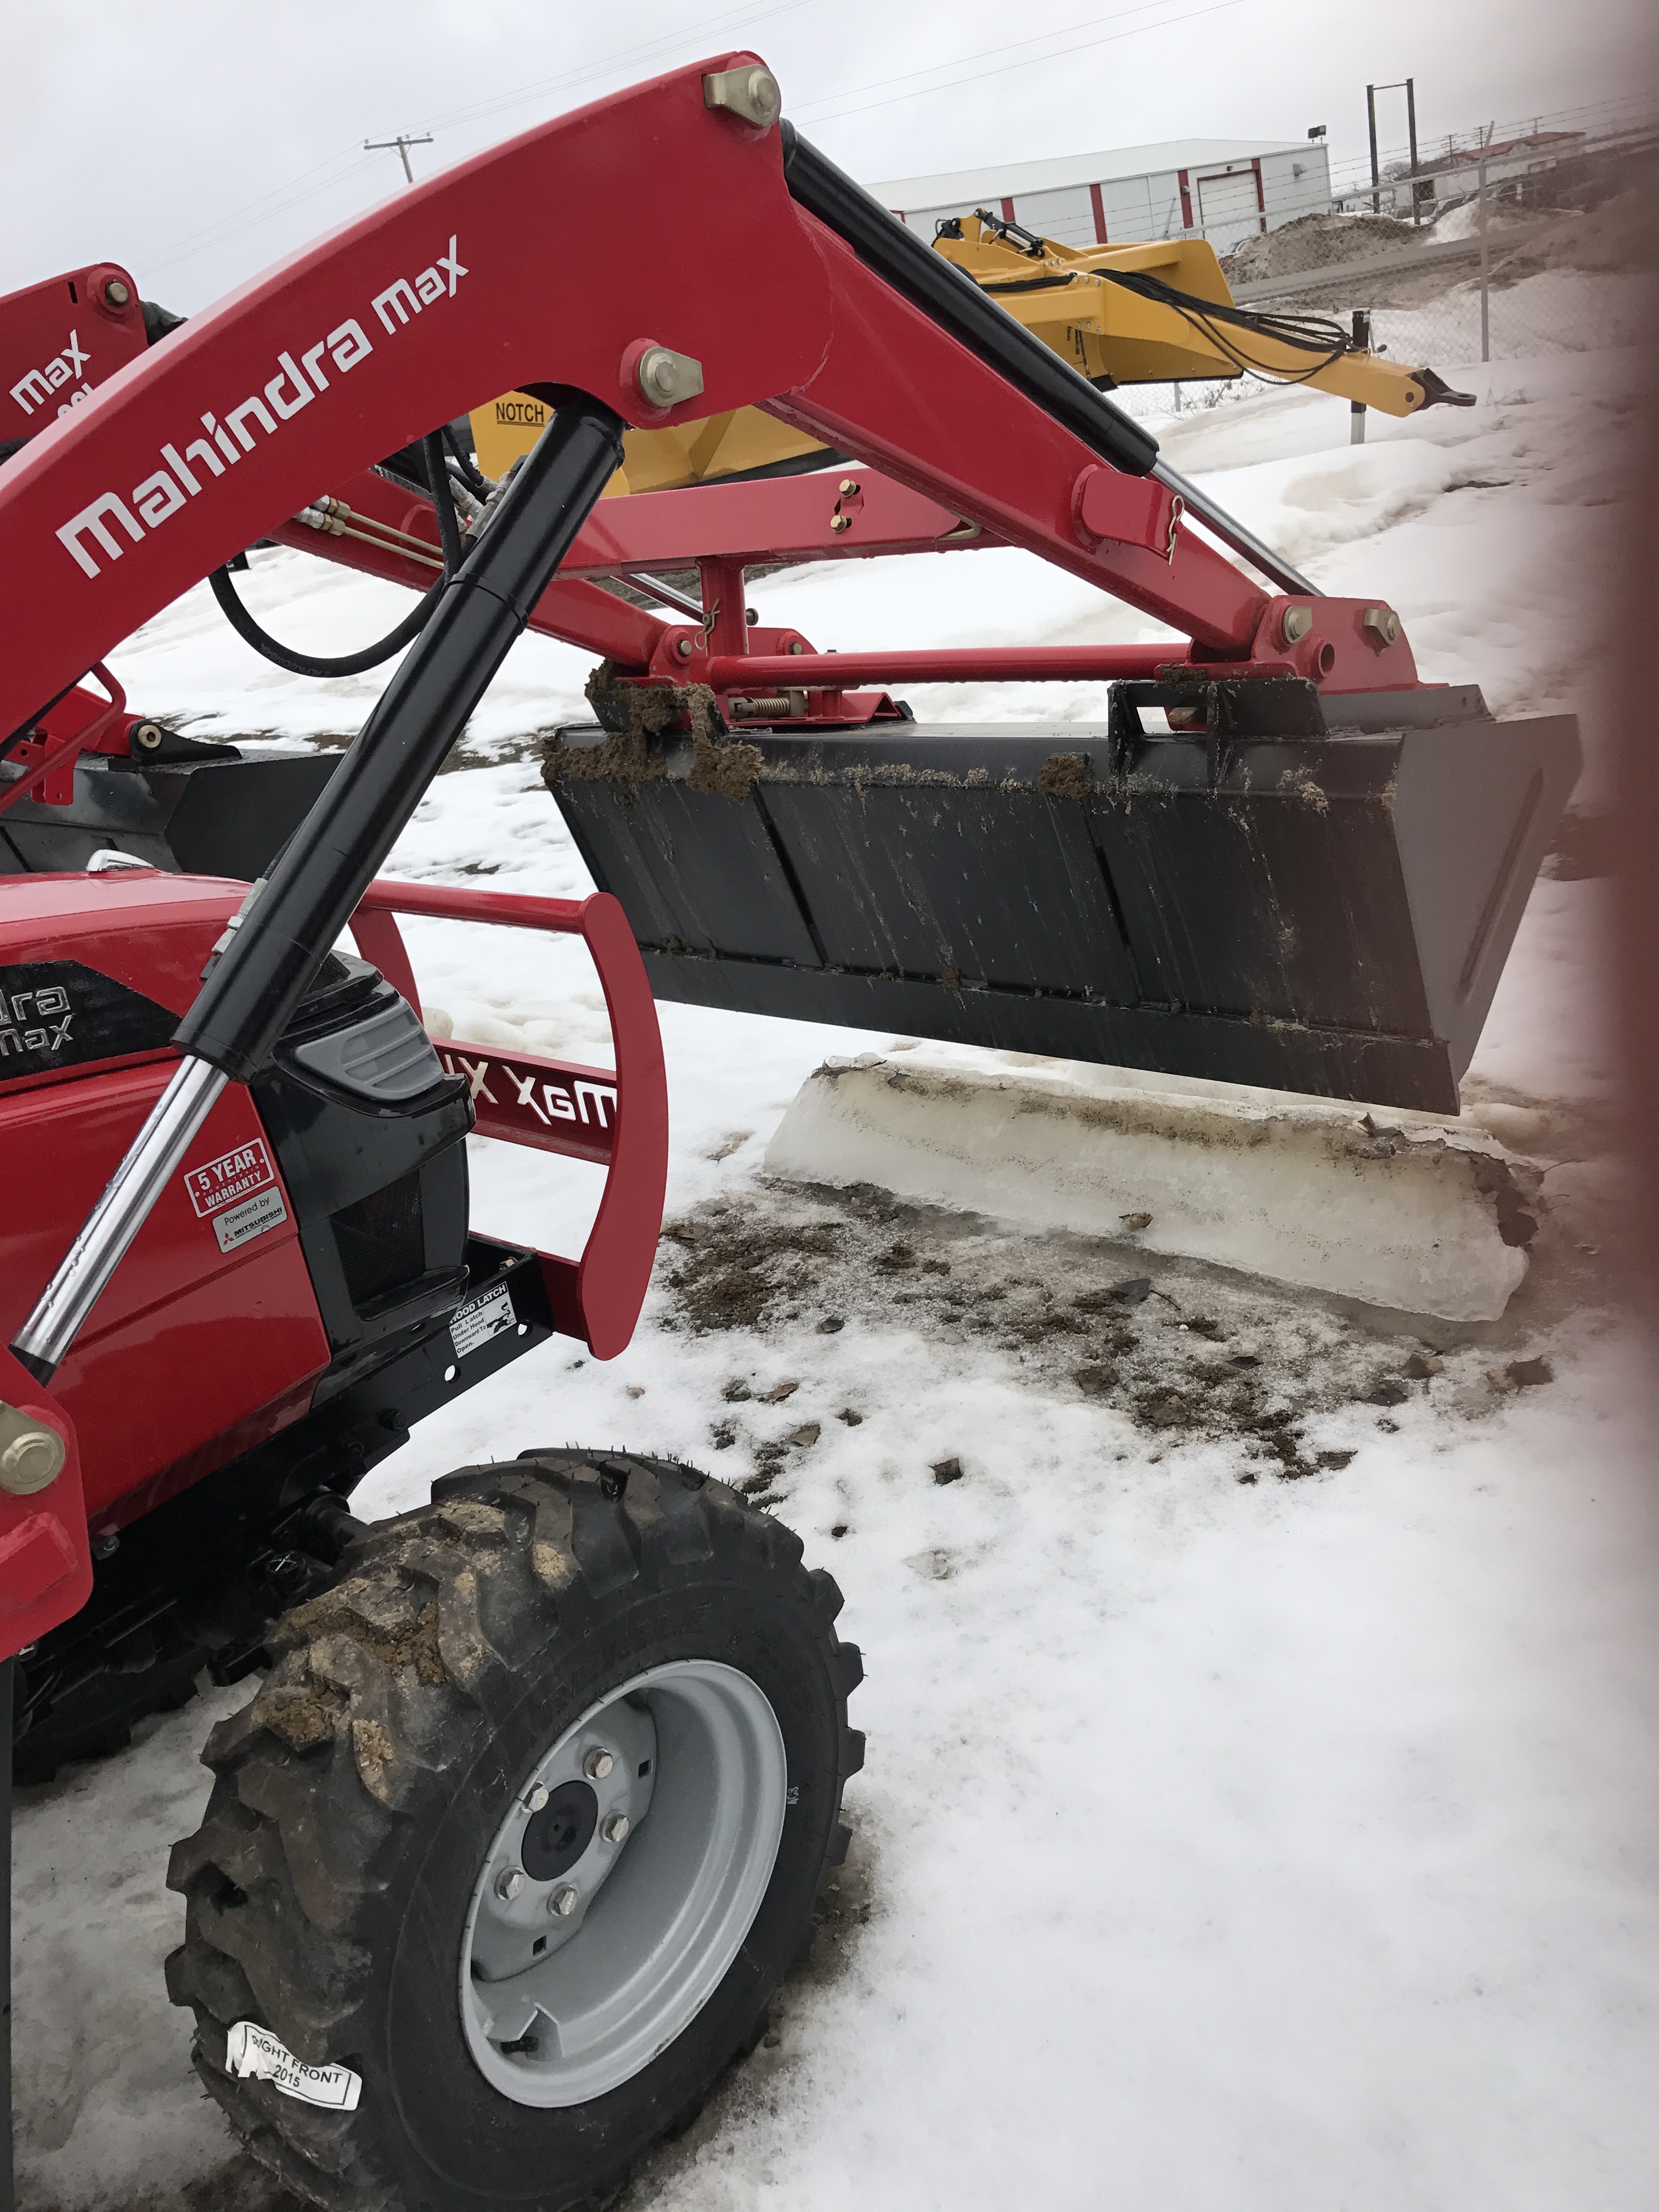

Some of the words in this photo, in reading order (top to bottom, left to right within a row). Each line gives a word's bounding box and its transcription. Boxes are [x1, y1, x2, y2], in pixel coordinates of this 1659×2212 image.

[496, 402, 544, 422] NOTCH
[198, 1172, 211, 1190] 5
[211, 1149, 257, 1182] YEAR
[205, 1170, 262, 1207] WARRANTY
[224, 1202, 258, 1226] Powered
[259, 1197, 269, 1207] by
[234, 1207, 283, 1237] MITSUBISHI
[477, 1284, 506, 1307] LATCH
[450, 1323, 462, 1333] Pull
[465, 1311, 483, 1324] Latch
[453, 1327, 470, 1340] Under
[470, 1318, 484, 1330] Hood
[454, 1329, 479, 1347] Downward
[457, 1342, 475, 1353] Open.
[273, 2064, 301, 2088] 2015
[291, 2058, 343, 2084] FRONT
